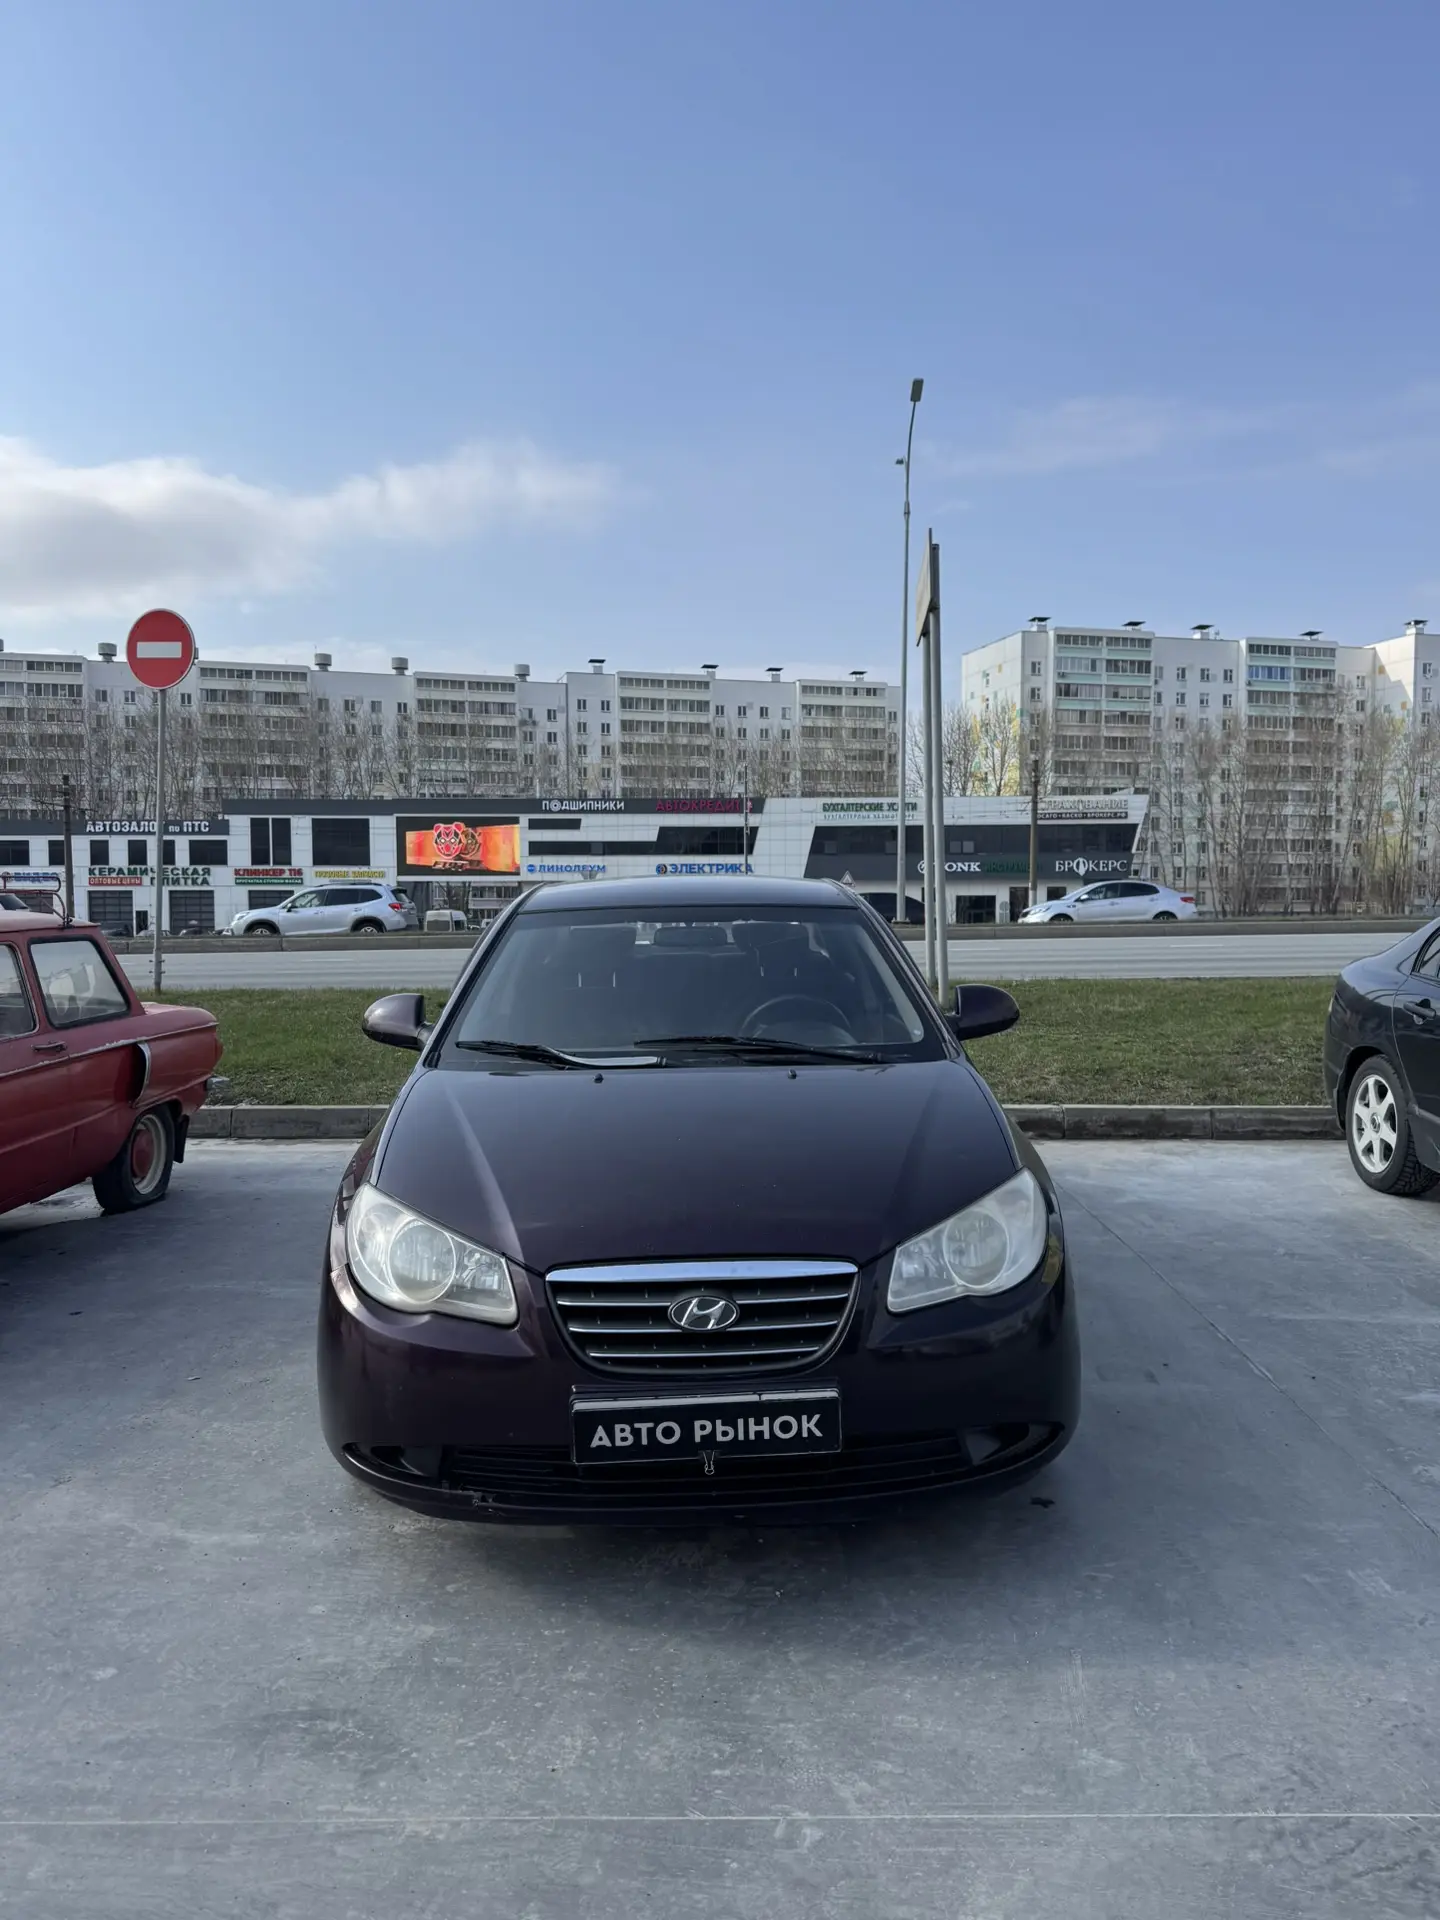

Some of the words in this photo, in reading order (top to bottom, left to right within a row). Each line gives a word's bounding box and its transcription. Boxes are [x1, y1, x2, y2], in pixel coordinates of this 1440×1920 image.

[542, 800, 625, 811] ПОДШИПНИКИ
[183, 821, 209, 832] ПТС
[538, 864, 606, 873] ЛИНОЛЕУМ
[1055, 857, 1127, 876] БРОКЕРС
[590, 1421, 681, 1448] АВТО
[694, 1414, 823, 1444] РЫНОК
